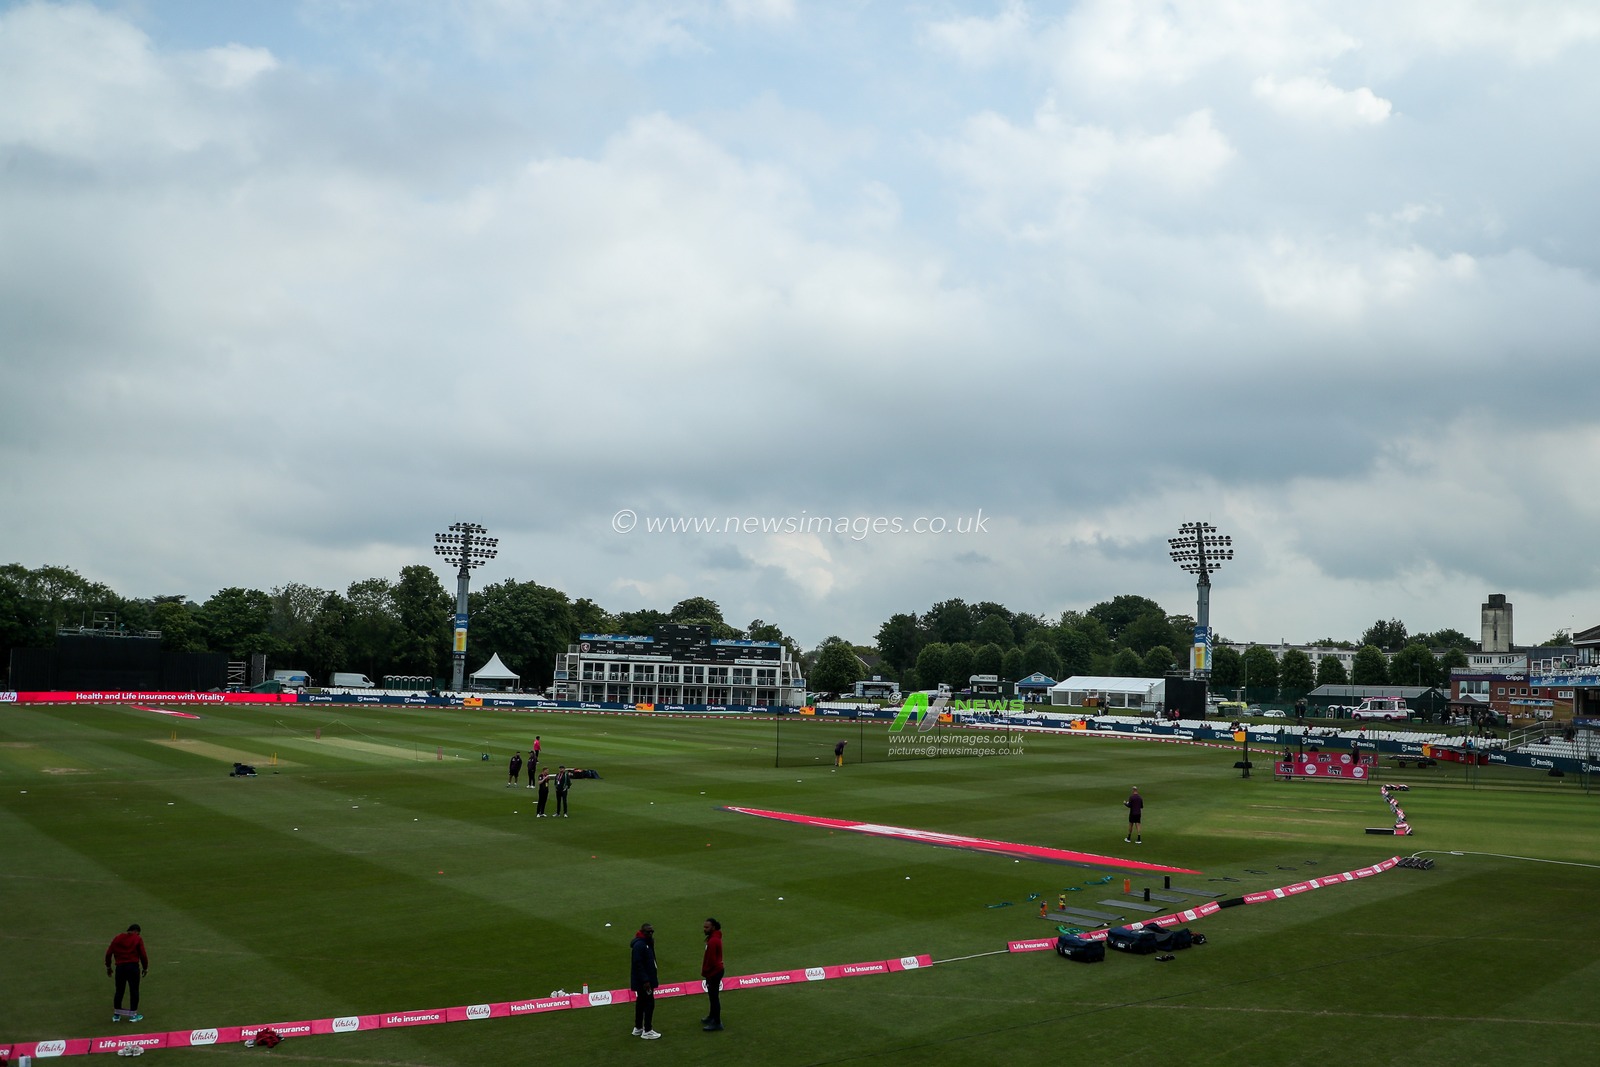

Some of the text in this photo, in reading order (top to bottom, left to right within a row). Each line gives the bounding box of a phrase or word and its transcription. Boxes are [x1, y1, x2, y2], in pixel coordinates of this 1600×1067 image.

[197, 693, 225, 702] Vitality
[1024, 941, 1049, 949] insurance
[856, 964, 883, 972] insurance
[739, 974, 790, 985] Health insurance
[653, 986, 680, 995] nsurance
[511, 1000, 570, 1012] Health insurance
[387, 1013, 440, 1024] Life insurance
[335, 1019, 357, 1029] Vitality
[191, 1031, 218, 1041] Vitality
[99, 1037, 159, 1048] Life insurance
[37, 1043, 65, 1053] Vitality
